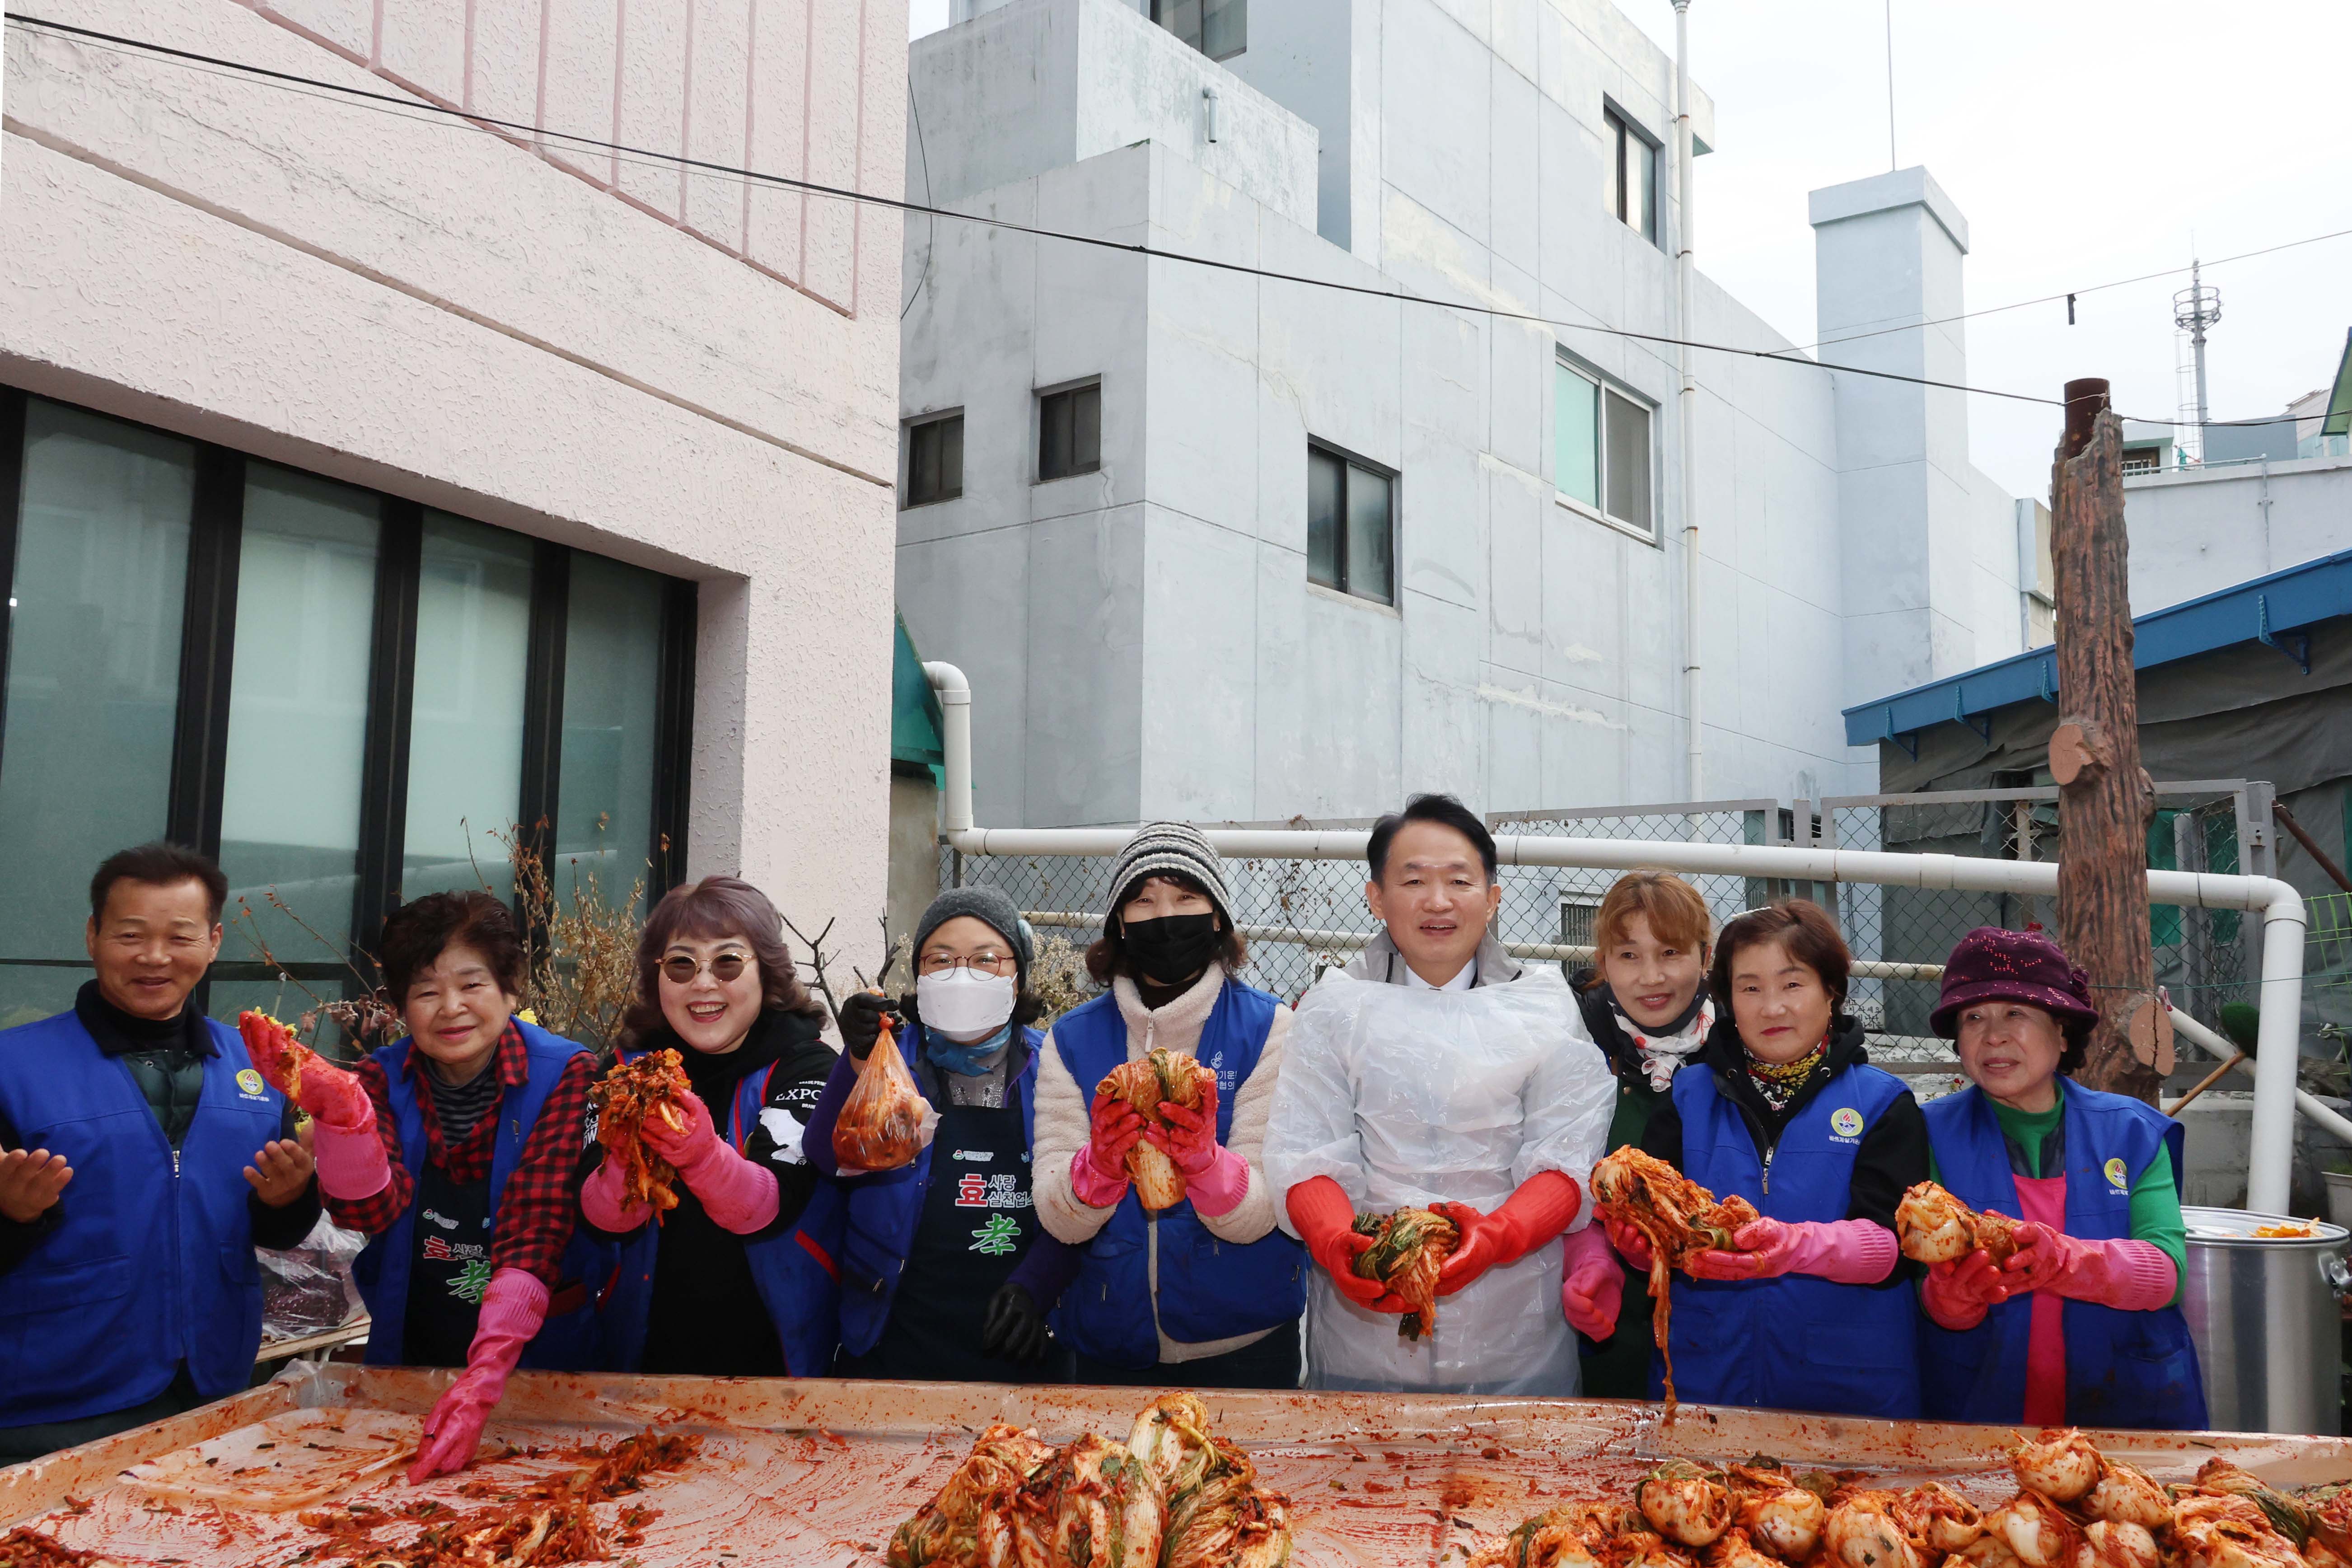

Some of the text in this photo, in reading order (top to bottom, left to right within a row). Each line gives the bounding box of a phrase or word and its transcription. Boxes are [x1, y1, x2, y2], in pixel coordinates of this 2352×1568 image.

[955, 1173, 1016, 1208] 효 사랑
[453, 1243, 483, 1256] 사랑
